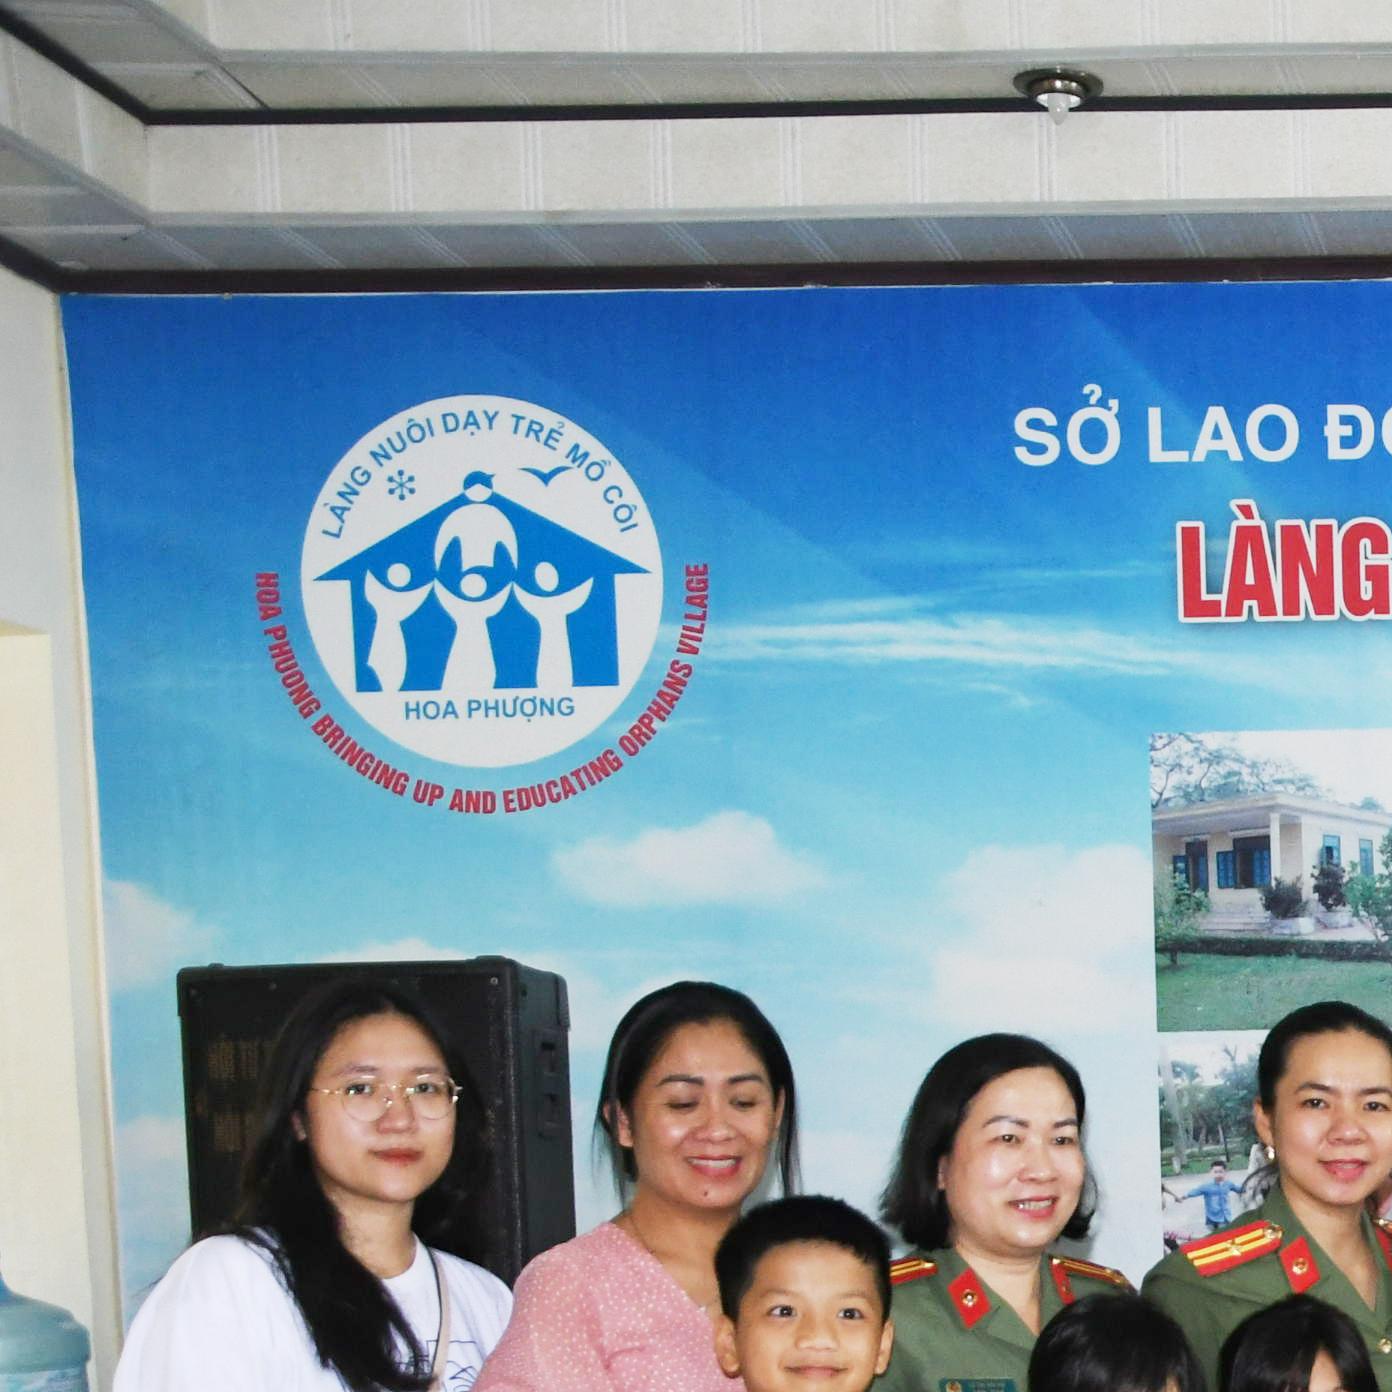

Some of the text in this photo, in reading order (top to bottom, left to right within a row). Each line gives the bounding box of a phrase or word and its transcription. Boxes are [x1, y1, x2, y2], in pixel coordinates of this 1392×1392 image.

[320, 409, 640, 540] LÀNG NUÔI DẠY TRẺ MỒ CÔI
[1013, 383, 1122, 467] SỞ
[1149, 402, 1301, 464] LAO
[253, 562, 711, 815] HOA PHUONG BRINGING UP AND EDUCATING ORPHANS VILLAGE
[403, 695, 576, 723] HOA PHƯỢNG
